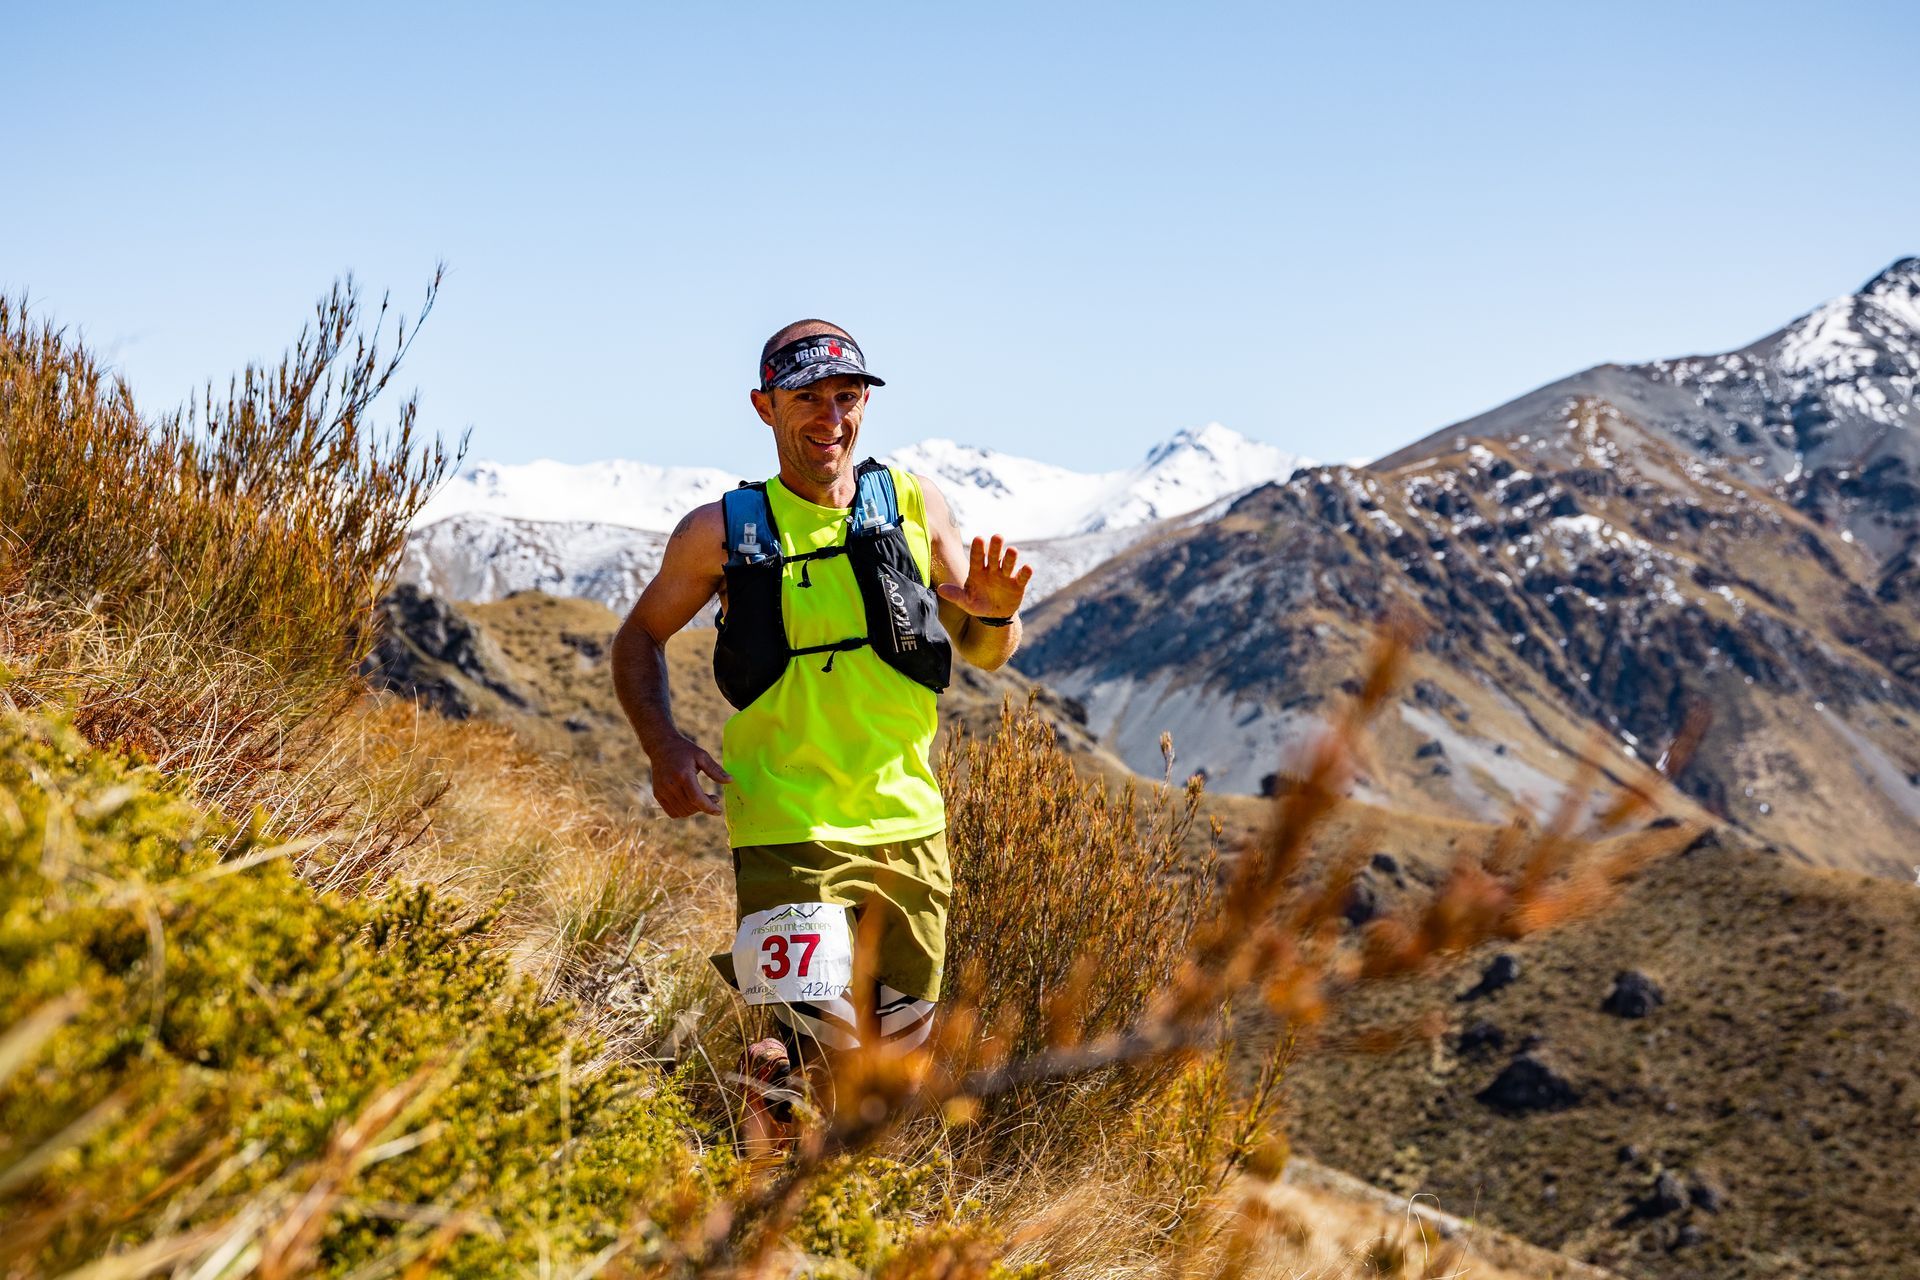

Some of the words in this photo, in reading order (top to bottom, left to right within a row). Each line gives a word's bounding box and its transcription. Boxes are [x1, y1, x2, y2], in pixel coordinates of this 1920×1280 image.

[750, 923, 782, 936] mission
[784, 922, 798, 931] mt
[799, 922, 832, 931] somers
[761, 934, 821, 980] 37
[802, 982, 845, 997] 42km
